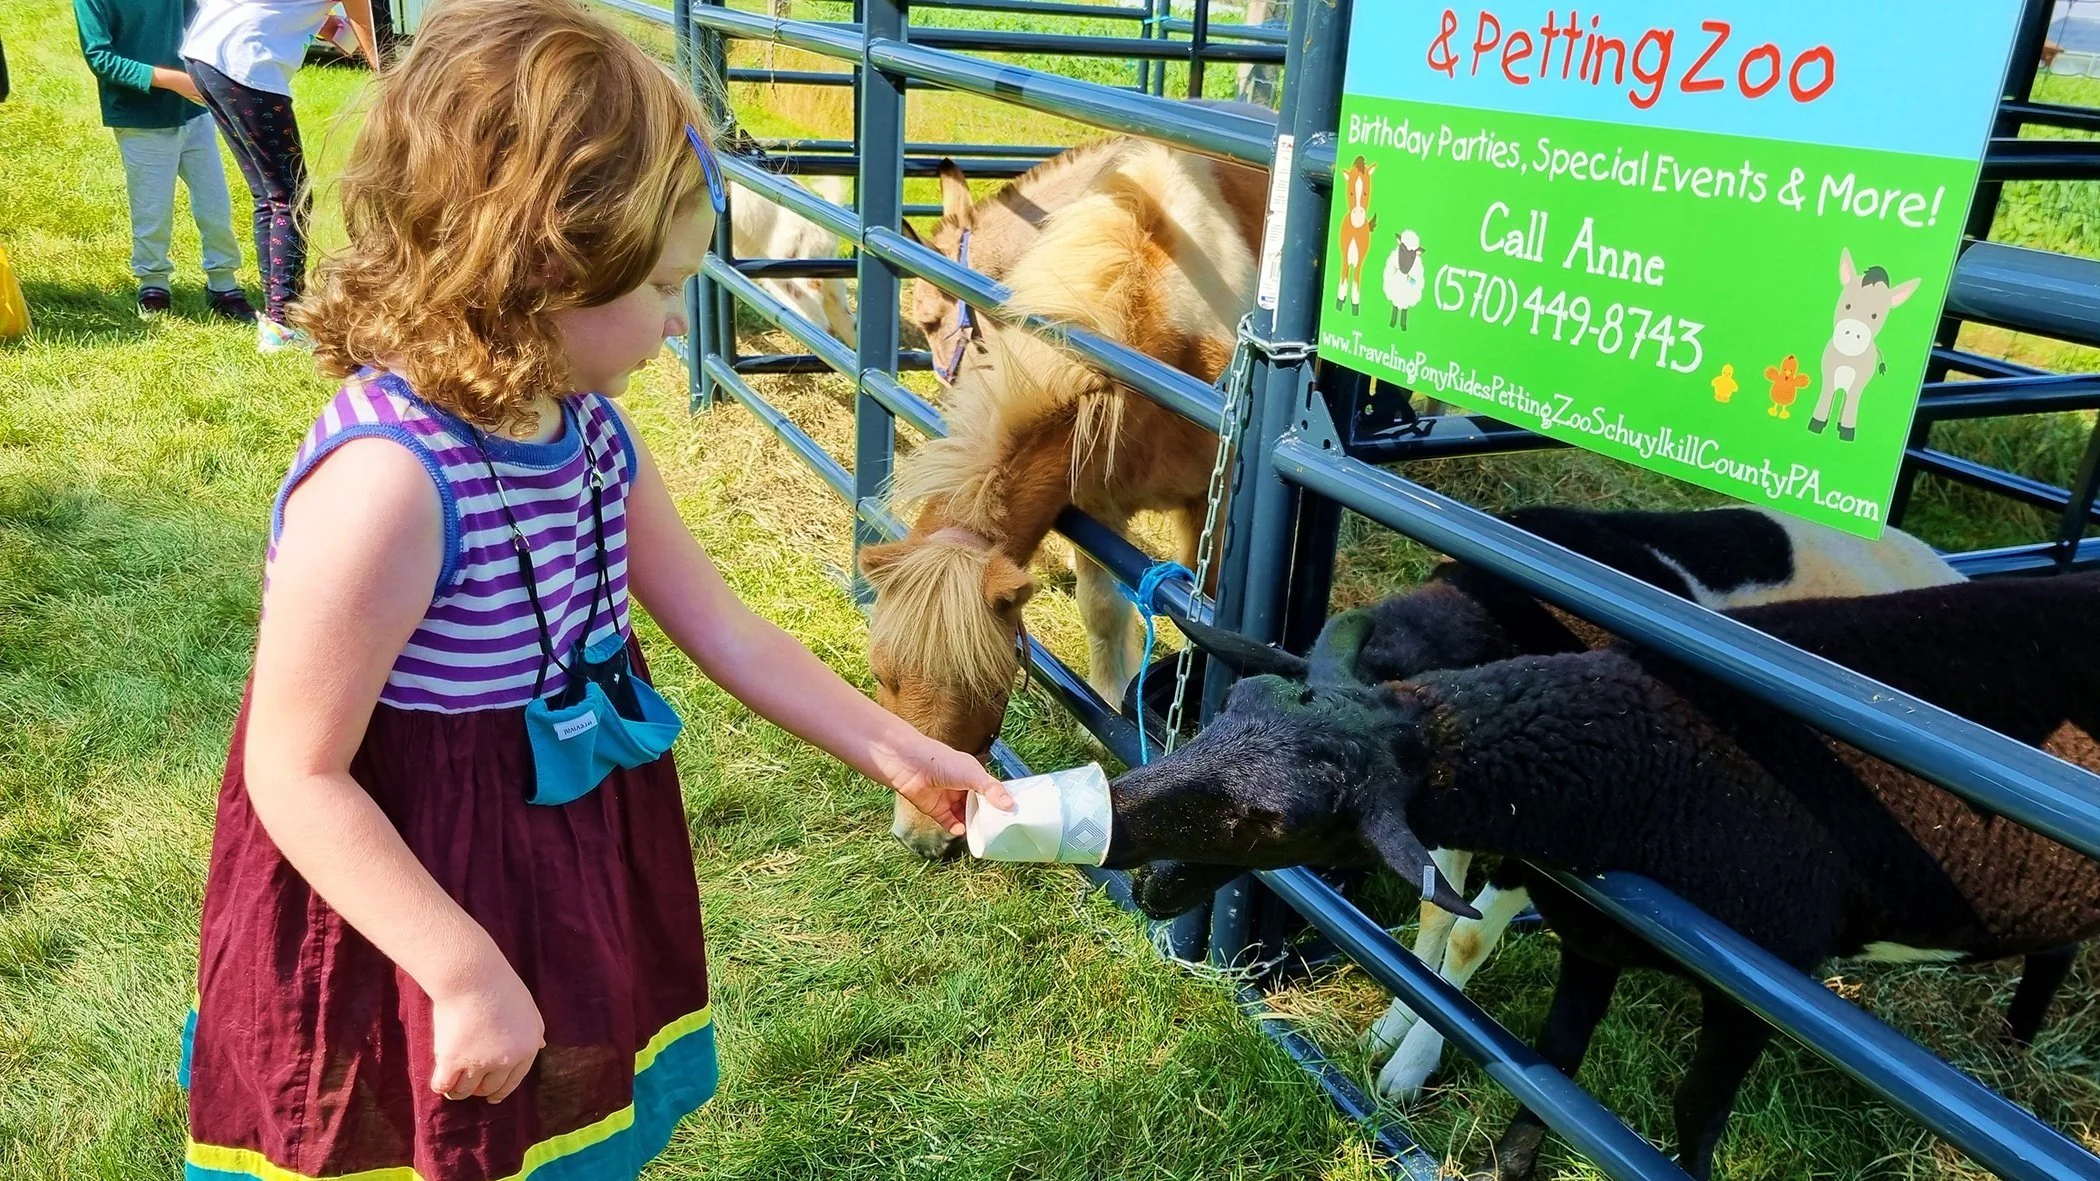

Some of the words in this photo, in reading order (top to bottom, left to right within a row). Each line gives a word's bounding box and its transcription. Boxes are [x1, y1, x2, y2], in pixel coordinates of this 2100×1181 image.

[1427, 9, 1459, 79] &
[1470, 10, 1675, 109] Petting
[1679, 20, 1836, 103] Zoo
[1348, 113, 1434, 161] Birthday
[1437, 124, 1528, 176] Parties,
[1532, 137, 1650, 187] Special
[1651, 153, 1768, 203] Events
[1777, 167, 1806, 212] &
[1817, 172, 1946, 228] More!
[1480, 201, 1549, 263] Call
[1562, 216, 1666, 287] Anne
[1434, 264, 1518, 327] (570)
[1523, 285, 1706, 374] 449-8743
[1321, 329, 1880, 522] www.TravelingPonyRidesPettingZooSchuylkillCountyPA.com
